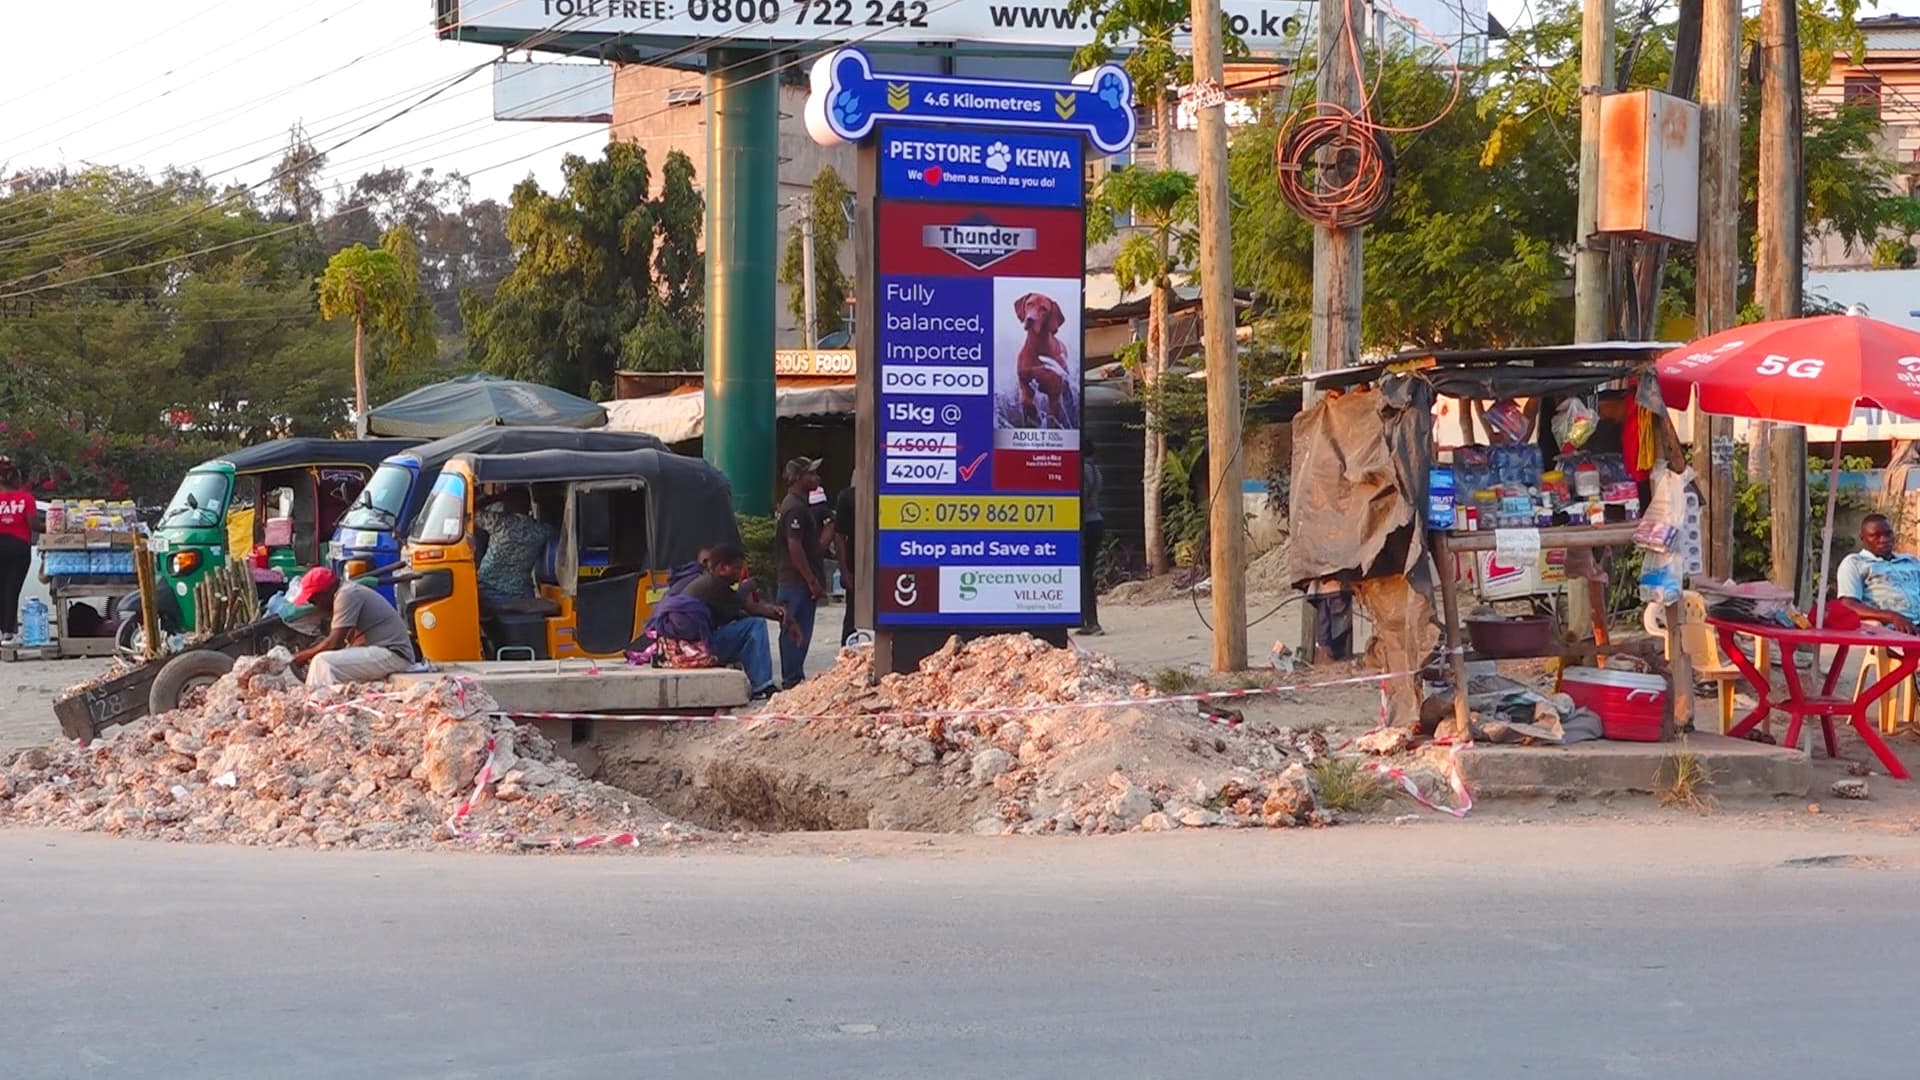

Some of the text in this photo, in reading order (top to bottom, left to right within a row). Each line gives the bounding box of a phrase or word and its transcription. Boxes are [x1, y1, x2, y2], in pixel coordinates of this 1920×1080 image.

[541, 0, 928, 28] TOLL FREE: 0800 722 242
[923, 92, 1042, 112] 4.6 Kilometres
[890, 141, 1072, 169] PETSTORE KENYA
[908, 169, 1056, 188] We them as much as you do!
[940, 227, 1021, 247] Thunder
[887, 284, 935, 306] Fully
[887, 313, 985, 334] balanced,
[887, 342, 982, 363] Imported
[816, 353, 852, 373] FOOD
[1756, 354, 1825, 379] 5G
[886, 372, 985, 388] DOG FOOD
[887, 403, 962, 425] 15kg @
[1012, 431, 1047, 442] ADULT
[891, 462, 949, 481] 4200/-
[0, 499, 25, 515] TAFF
[1429, 495, 1454, 505] TRUST
[936, 504, 1055, 523] 0759 862 071
[900, 541, 1057, 558] Shop and Save at:
[959, 569, 1063, 601] greenwood
[1014, 589, 1064, 601] VILLAGE
